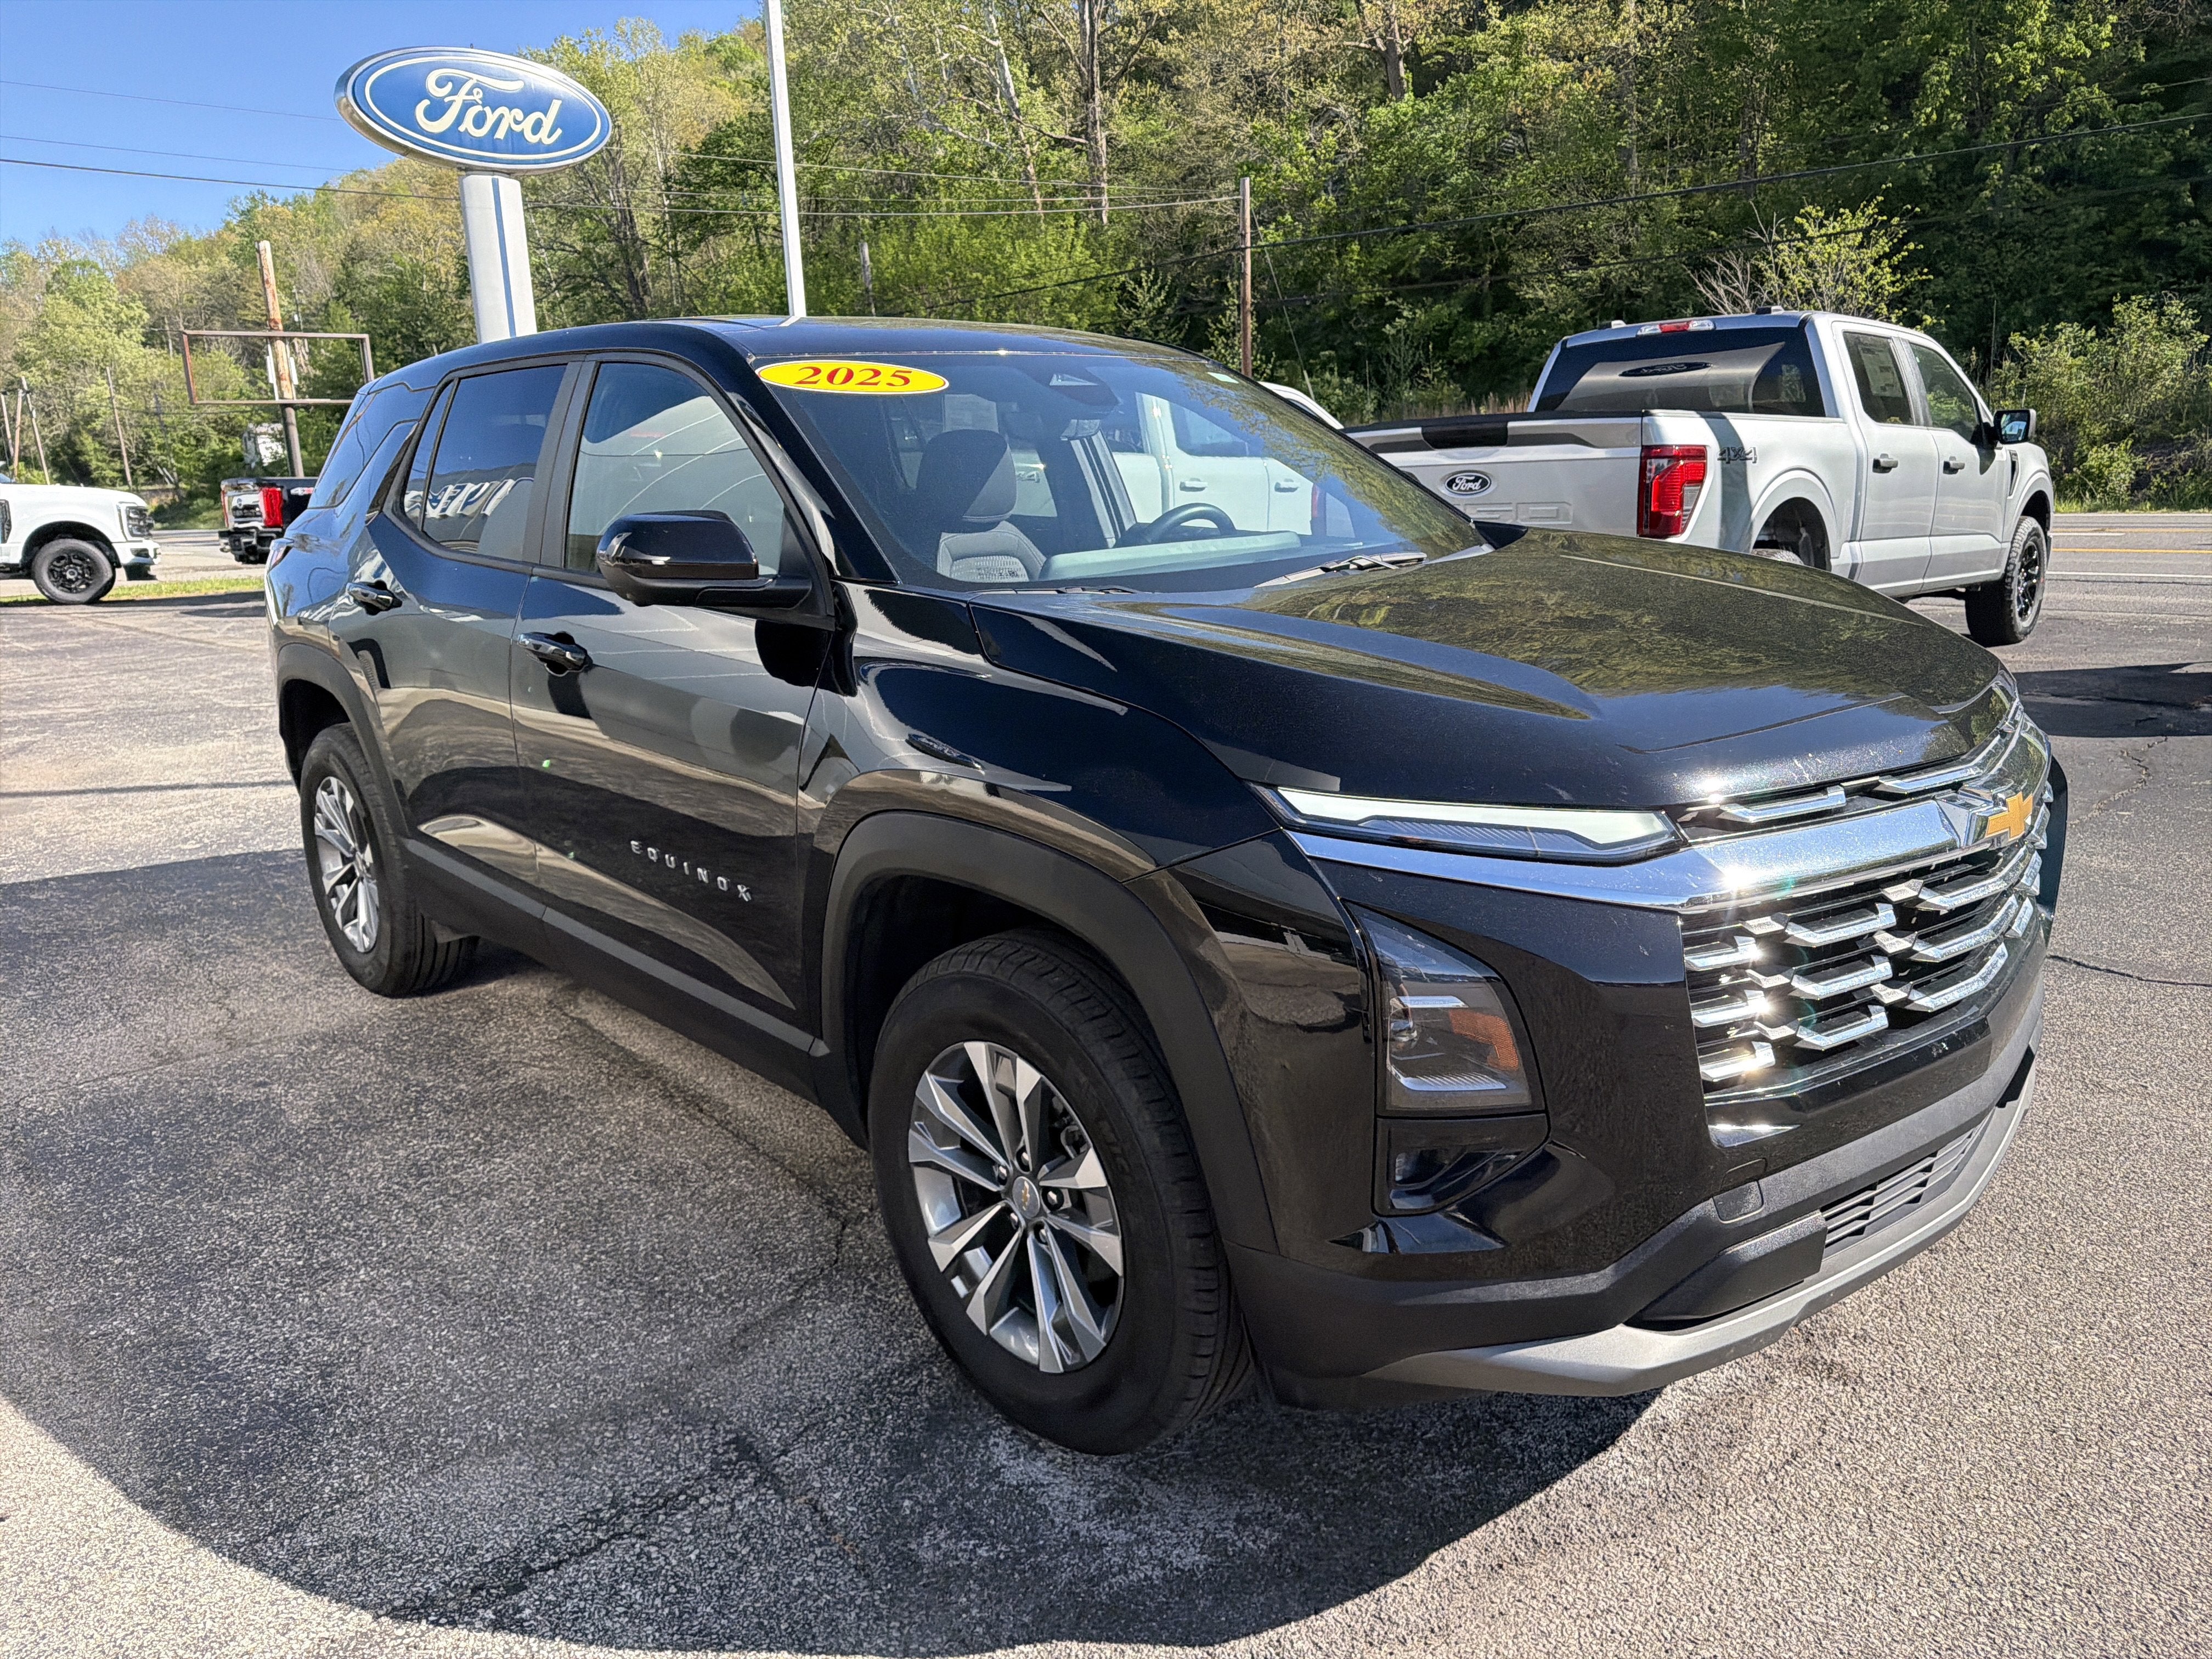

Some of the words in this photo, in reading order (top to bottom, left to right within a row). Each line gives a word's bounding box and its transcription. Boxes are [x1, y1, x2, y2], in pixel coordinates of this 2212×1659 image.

[415, 68, 562, 144] Ford
[793, 366, 912, 386] 2025
[1452, 475, 1482, 491] Ford
[631, 840, 752, 901] EQUINOX
